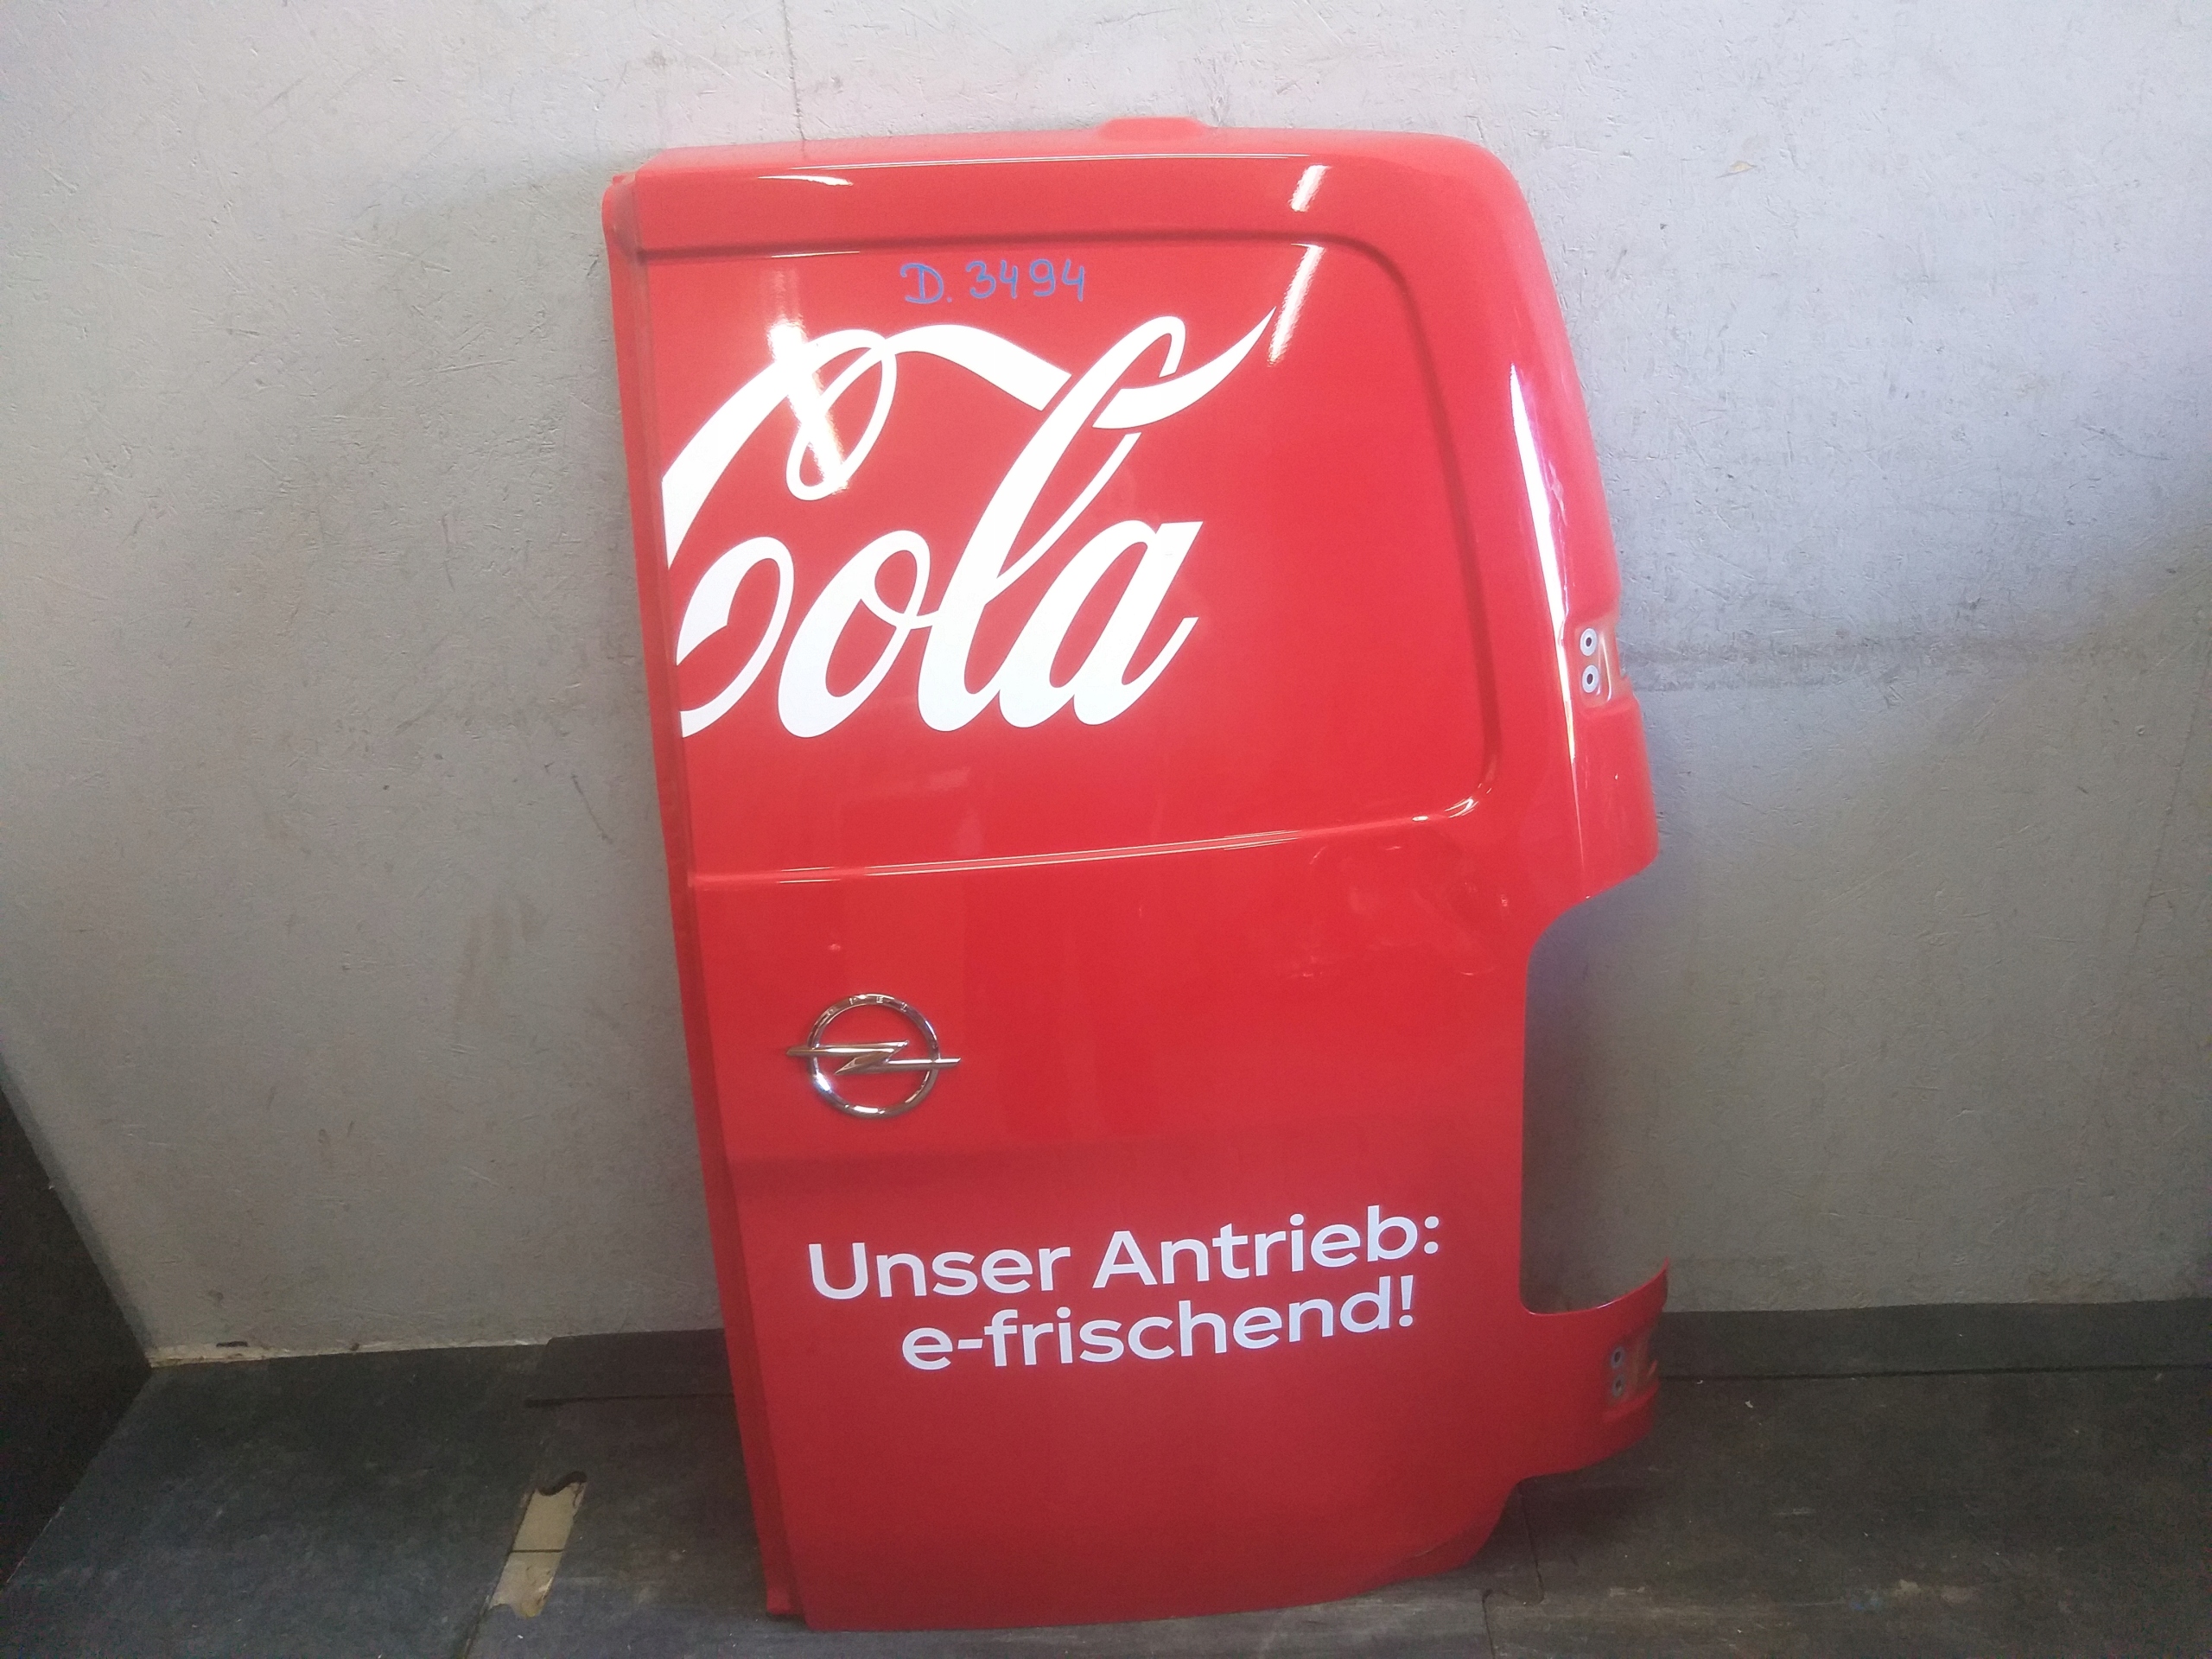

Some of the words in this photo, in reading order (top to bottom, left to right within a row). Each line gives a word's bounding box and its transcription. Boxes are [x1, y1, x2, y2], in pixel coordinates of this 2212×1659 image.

[899, 262, 952, 304] D.
[965, 258, 1085, 302] 3494
[661, 306, 1276, 739] Cola
[808, 1242, 1071, 1300] Unser
[1091, 1204, 1440, 1289] Antrieb:
[901, 1274, 1414, 1370] e-frischend!
